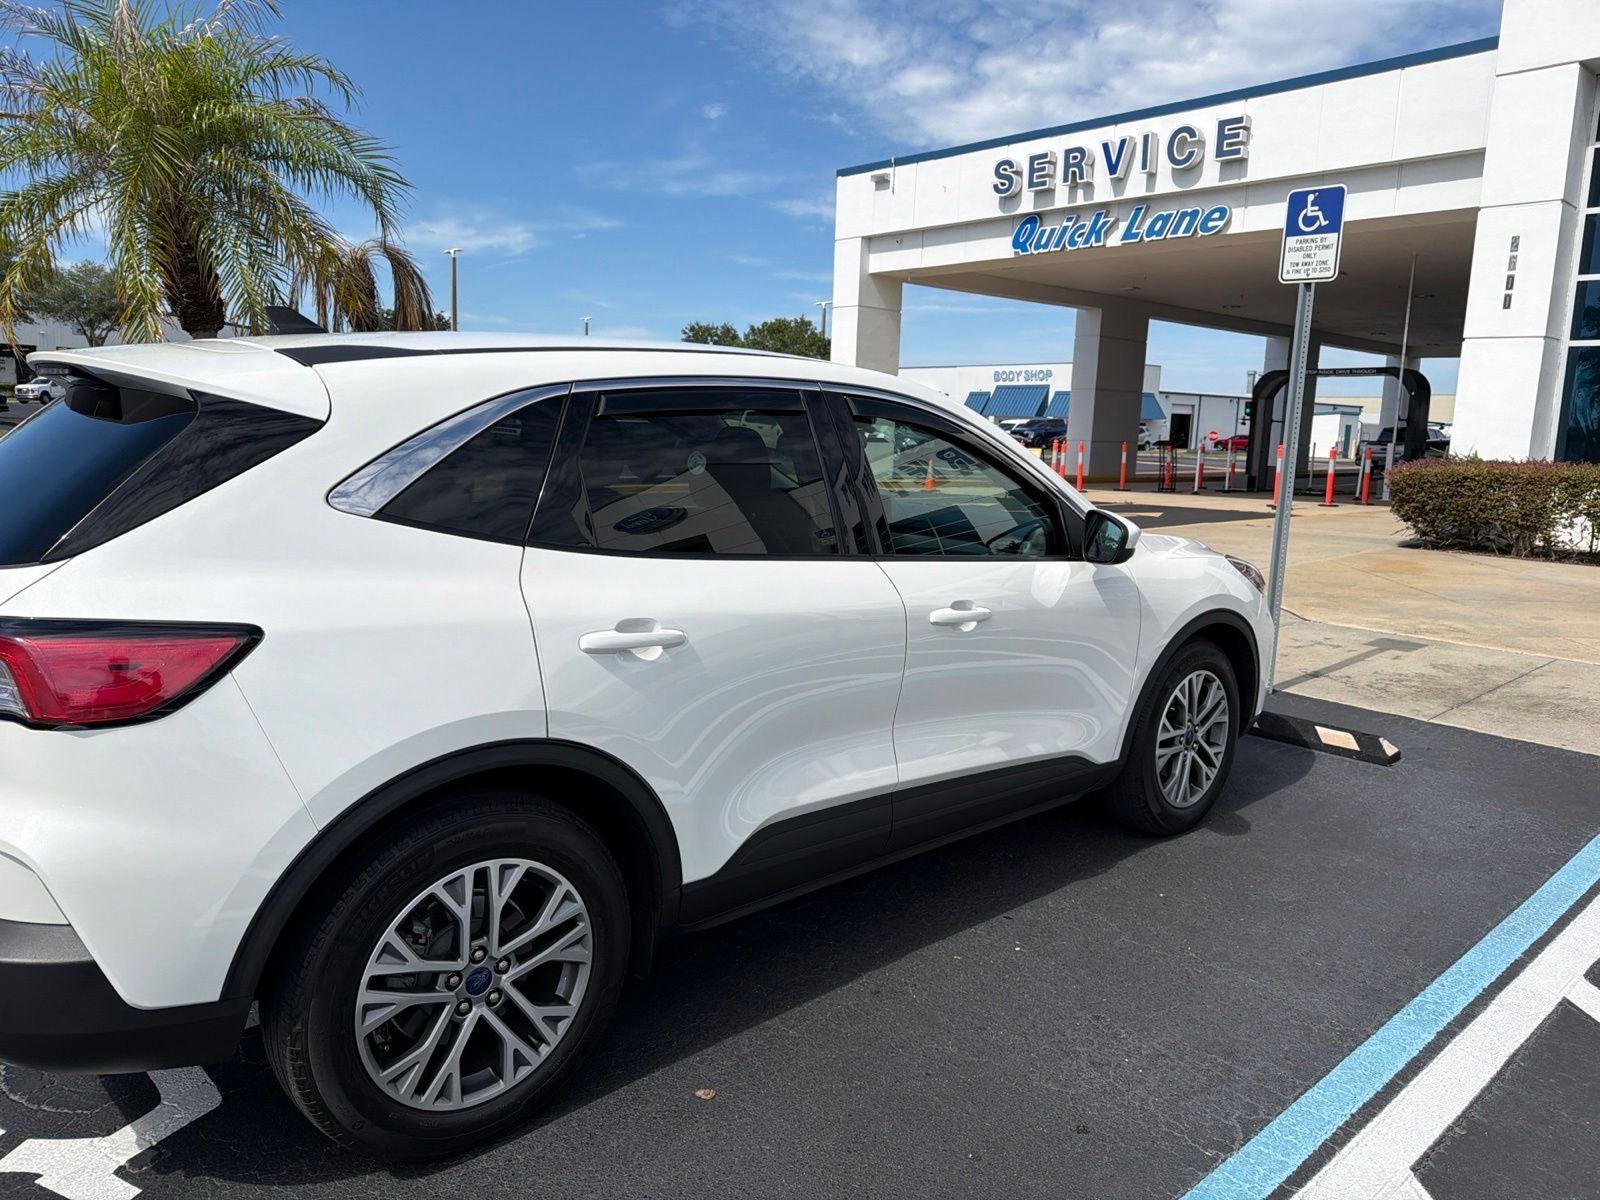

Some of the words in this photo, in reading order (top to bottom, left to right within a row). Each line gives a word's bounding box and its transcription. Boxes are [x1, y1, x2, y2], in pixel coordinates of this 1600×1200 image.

[992, 114, 1251, 197] SERVICE
[1011, 208, 1116, 255] Quick
[1120, 203, 1231, 243] Lane
[1287, 245, 1313, 253] DISABLED
[1314, 243, 1334, 251] PERMIT
[993, 370, 1022, 382] BODY
[1024, 369, 1053, 382] SHOP
